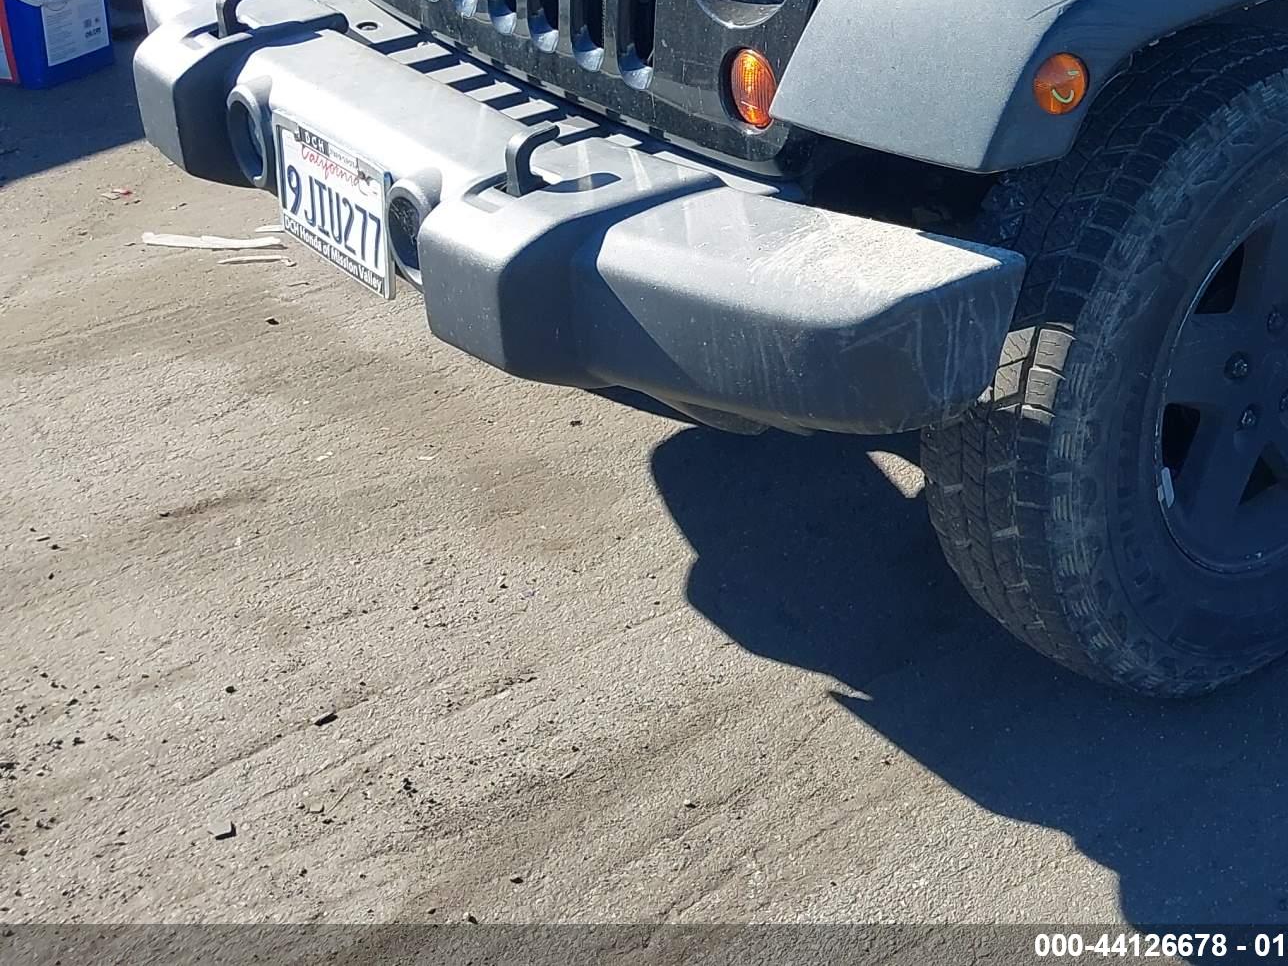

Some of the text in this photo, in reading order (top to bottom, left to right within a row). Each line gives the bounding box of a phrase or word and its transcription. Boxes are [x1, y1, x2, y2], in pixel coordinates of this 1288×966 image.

[301, 144, 361, 187] California
[284, 216, 300, 242] DCH
[300, 225, 323, 251] Honda
[330, 245, 359, 277] Mission
[358, 262, 383, 294] Valley
